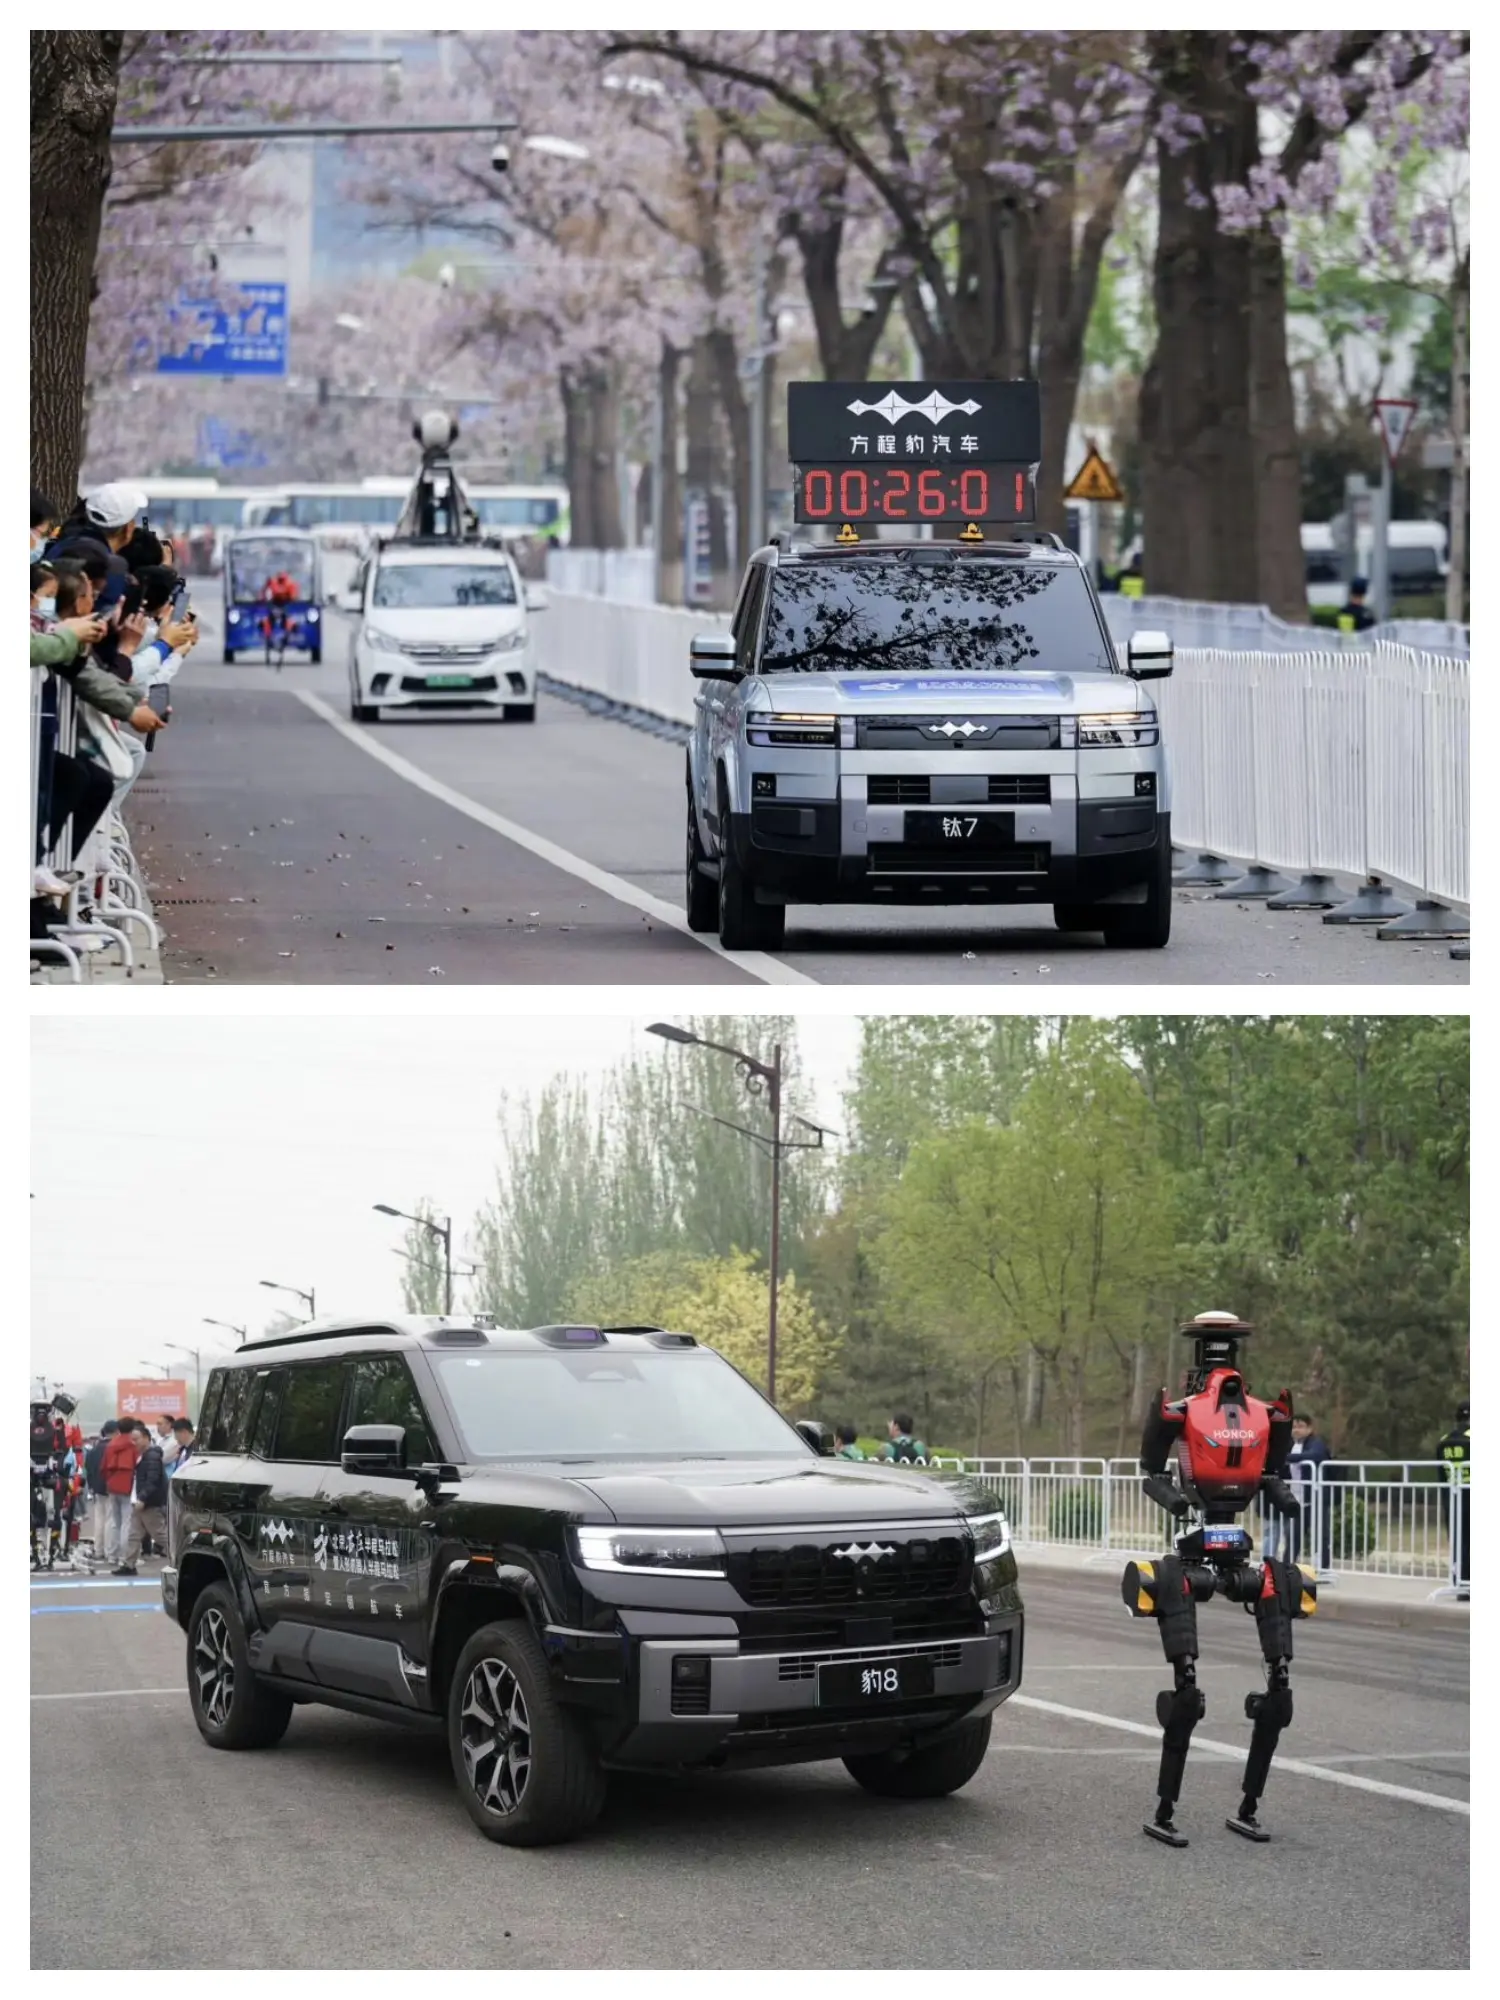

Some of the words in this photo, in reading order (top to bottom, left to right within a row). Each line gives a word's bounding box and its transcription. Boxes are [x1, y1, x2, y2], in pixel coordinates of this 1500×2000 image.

[850, 434, 979, 454] 方程豹汽车
[805, 470, 1023, 516] 00:26:01
[942, 816, 978, 838] 钛7
[1213, 1429, 1256, 1440] HONOR
[861, 1668, 898, 1694] 豹8
